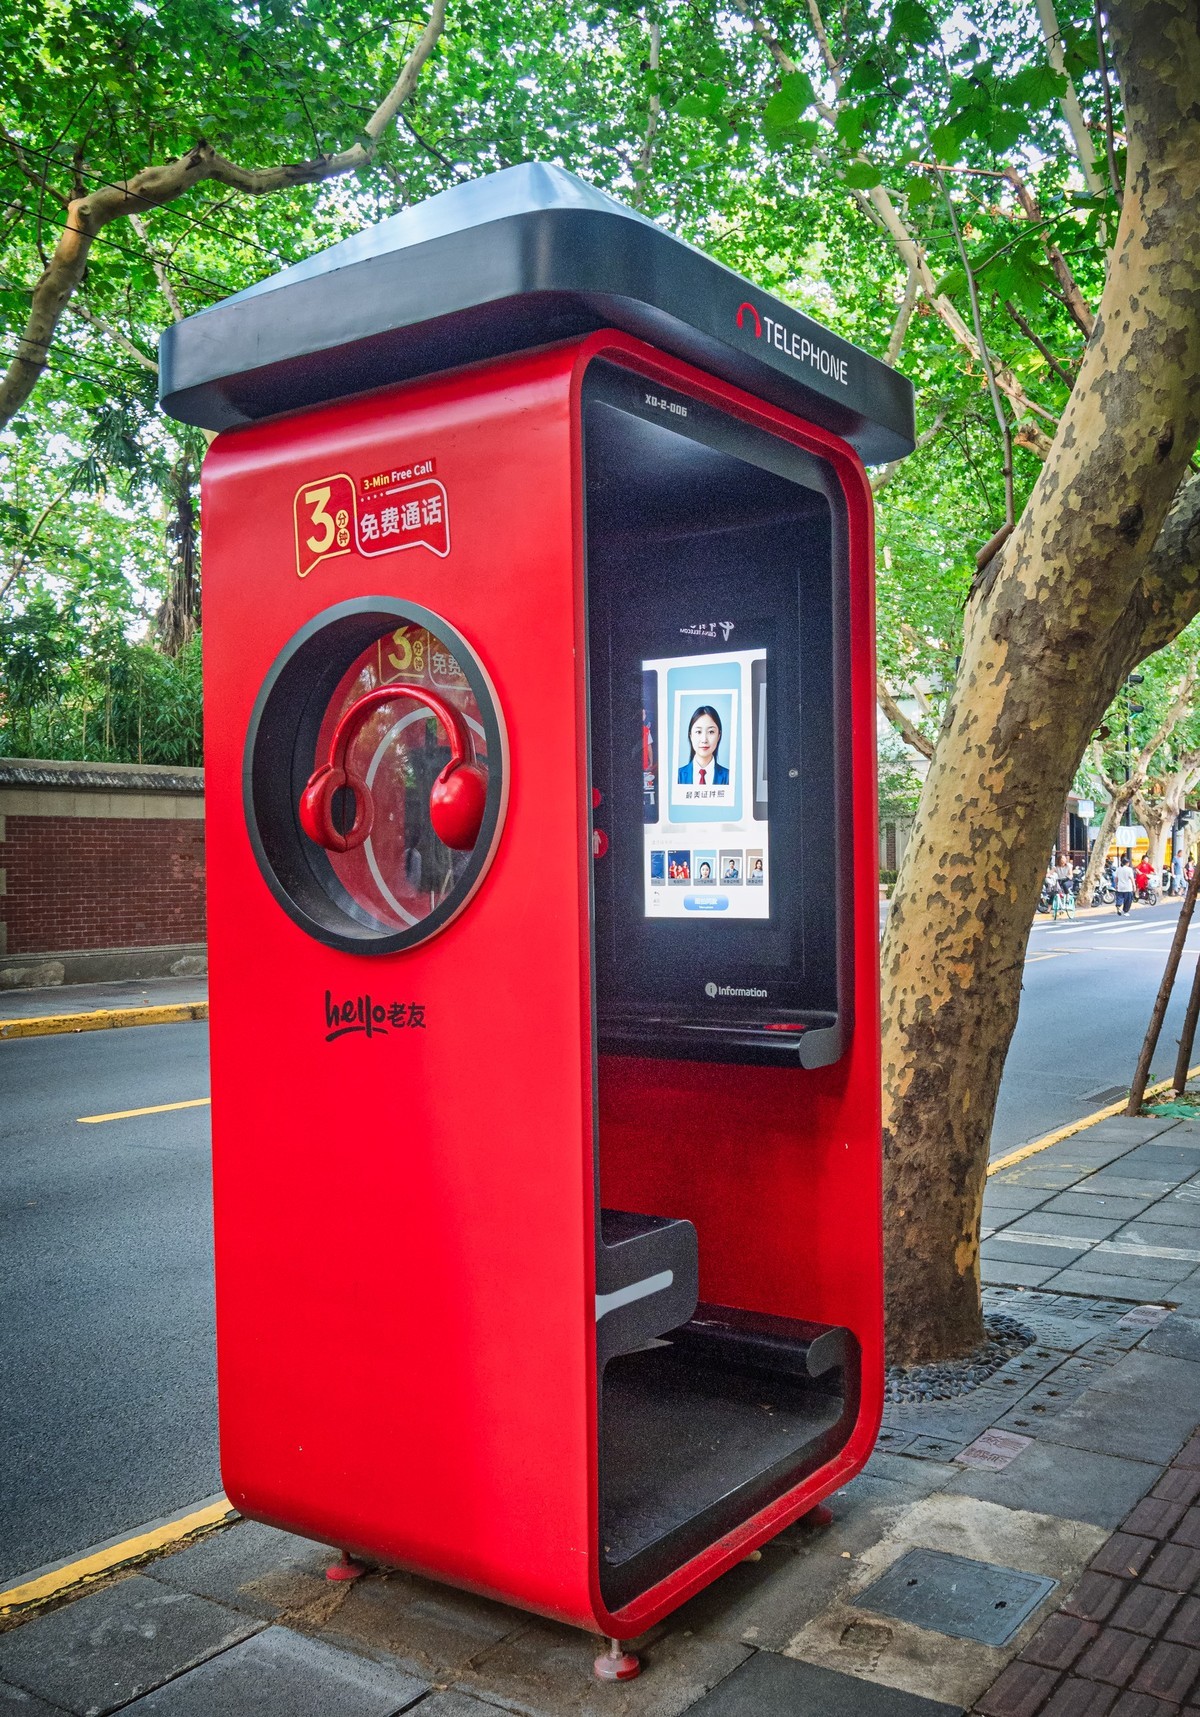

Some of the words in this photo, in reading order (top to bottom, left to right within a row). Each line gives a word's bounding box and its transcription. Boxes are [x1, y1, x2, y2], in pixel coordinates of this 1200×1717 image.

[763, 316, 849, 386] TELEPHONE
[364, 474, 390, 490] 3-Min
[391, 468, 412, 483] Free
[413, 460, 433, 477] Call
[361, 495, 442, 543] 免费通话
[718, 986, 768, 998] Information
